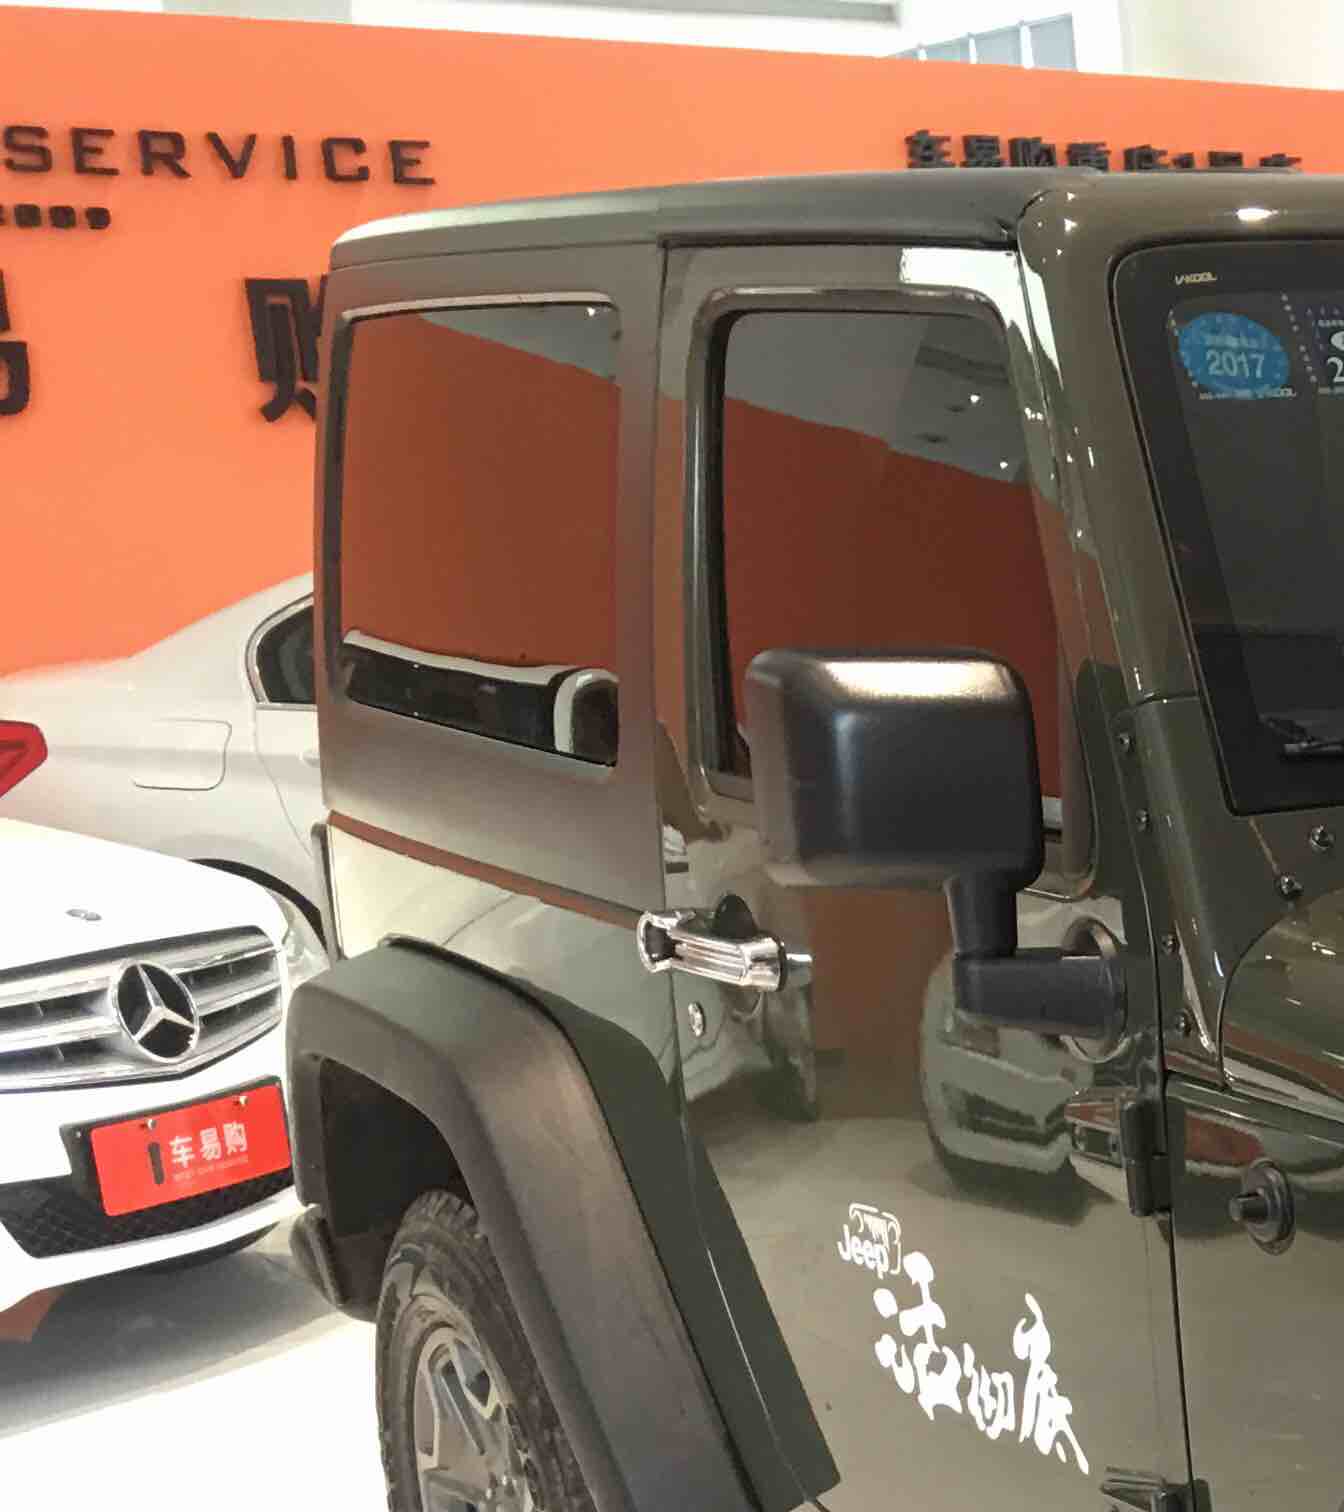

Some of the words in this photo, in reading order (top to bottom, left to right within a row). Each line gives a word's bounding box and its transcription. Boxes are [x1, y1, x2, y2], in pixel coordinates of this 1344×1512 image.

[2, 126, 436, 187] SERVICE
[1206, 350, 1266, 379] 2017
[169, 1121, 248, 1168] 车易购
[837, 1224, 889, 1280] Jeep
